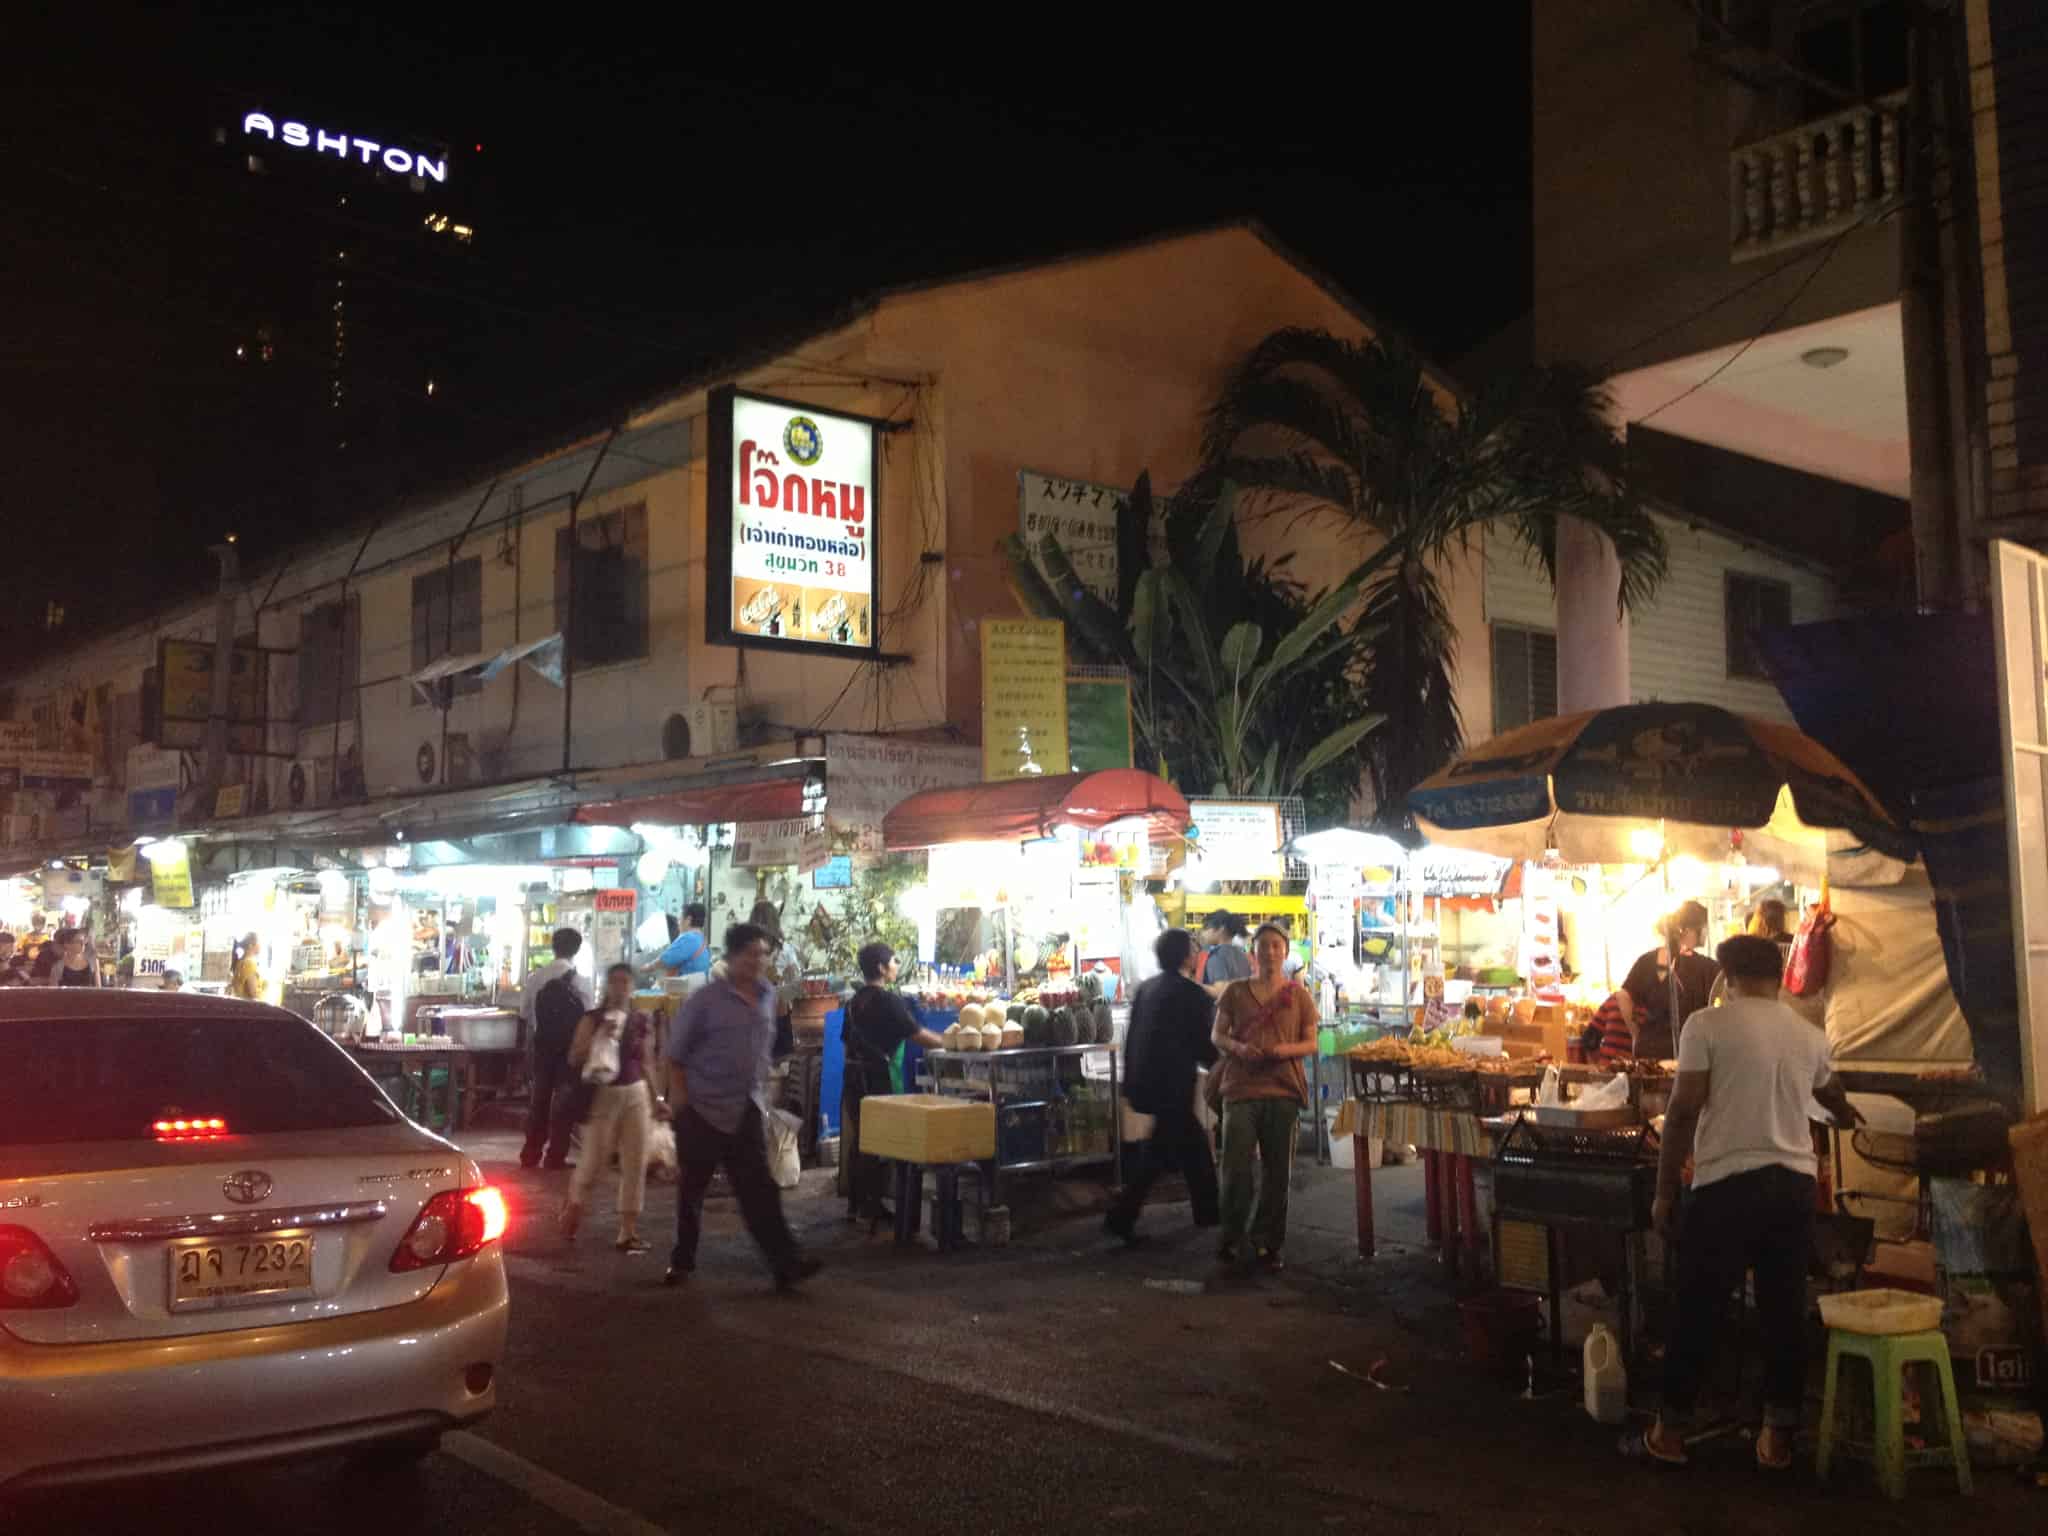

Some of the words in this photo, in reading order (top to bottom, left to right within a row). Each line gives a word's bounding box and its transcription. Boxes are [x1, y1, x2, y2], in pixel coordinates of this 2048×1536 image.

[244, 113, 445, 183] ASHTON
[739, 439, 865, 538] โจ๊กหมู
[825, 560, 847, 577] 38
[237, 1240, 306, 1275] 7232
